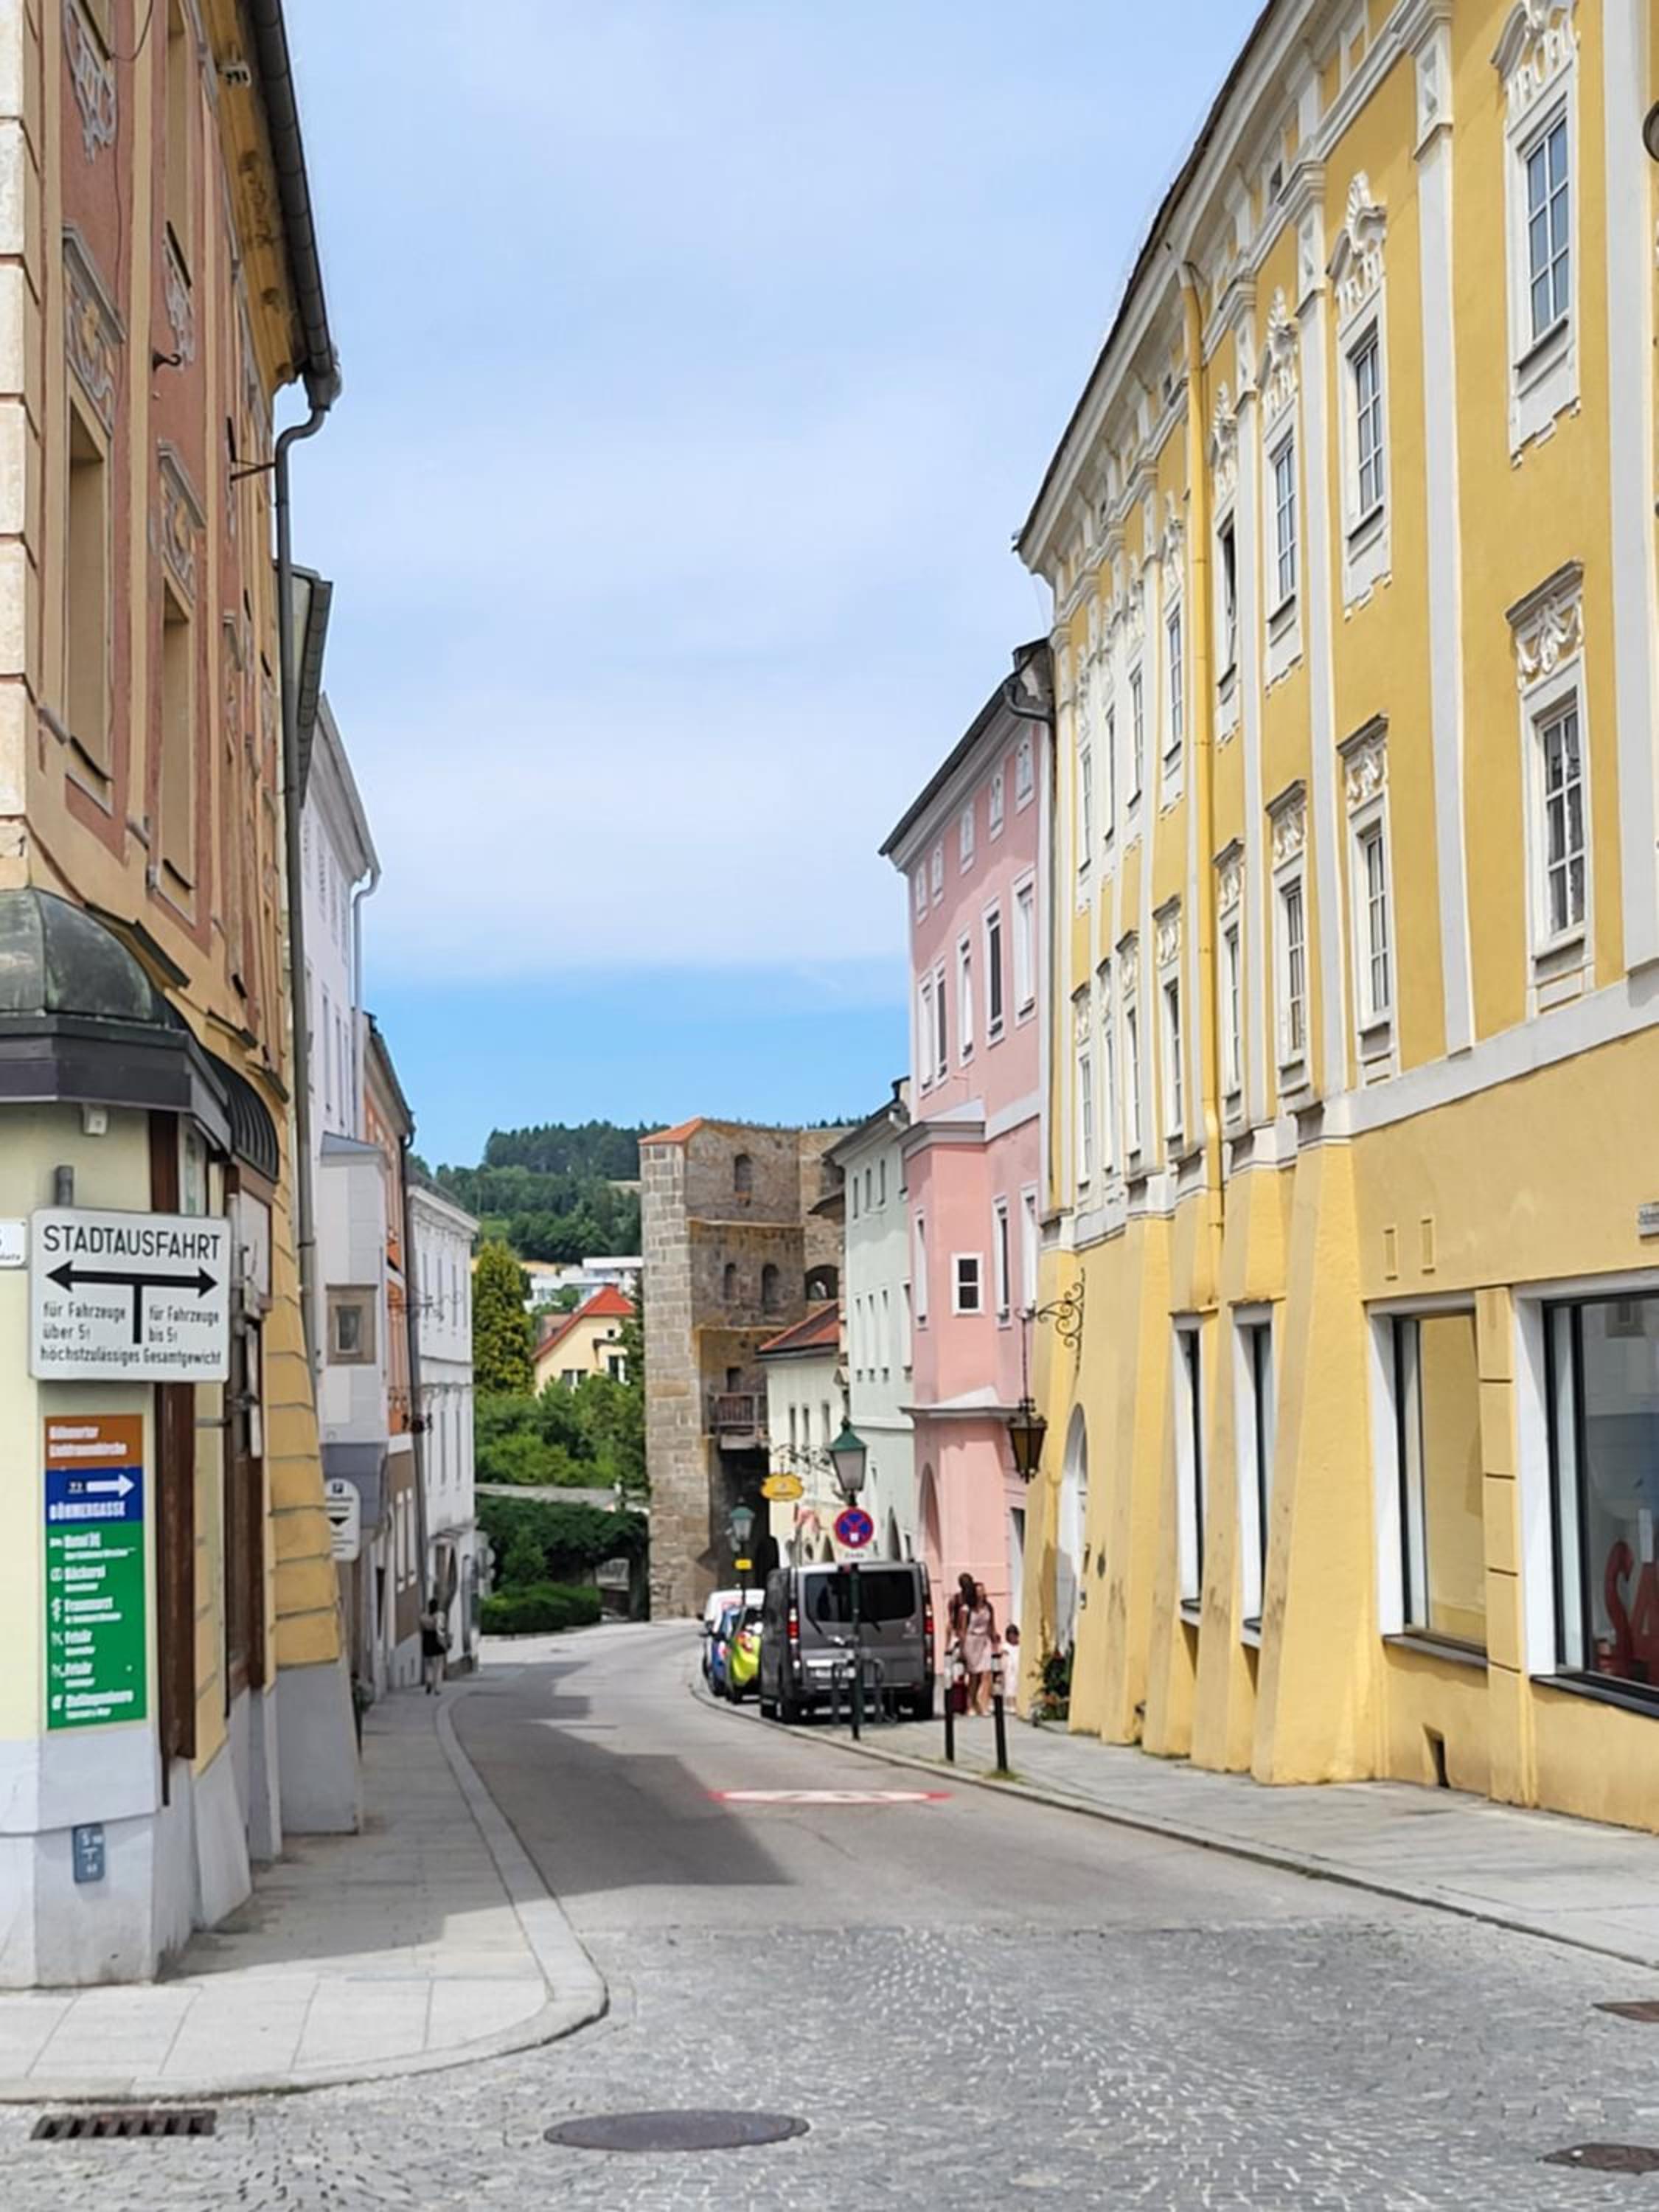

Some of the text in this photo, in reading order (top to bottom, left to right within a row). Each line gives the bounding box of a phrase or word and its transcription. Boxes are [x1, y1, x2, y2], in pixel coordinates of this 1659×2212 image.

[44, 1225, 220, 1260] STADTAUSFAHRT
[44, 1301, 125, 1324] für Fahrzeuge
[150, 1304, 218, 1327] für Fahrzeuge
[44, 1323, 73, 1340] über
[149, 1328, 163, 1342] bis
[144, 1347, 220, 1368] Gesamtgewicht
